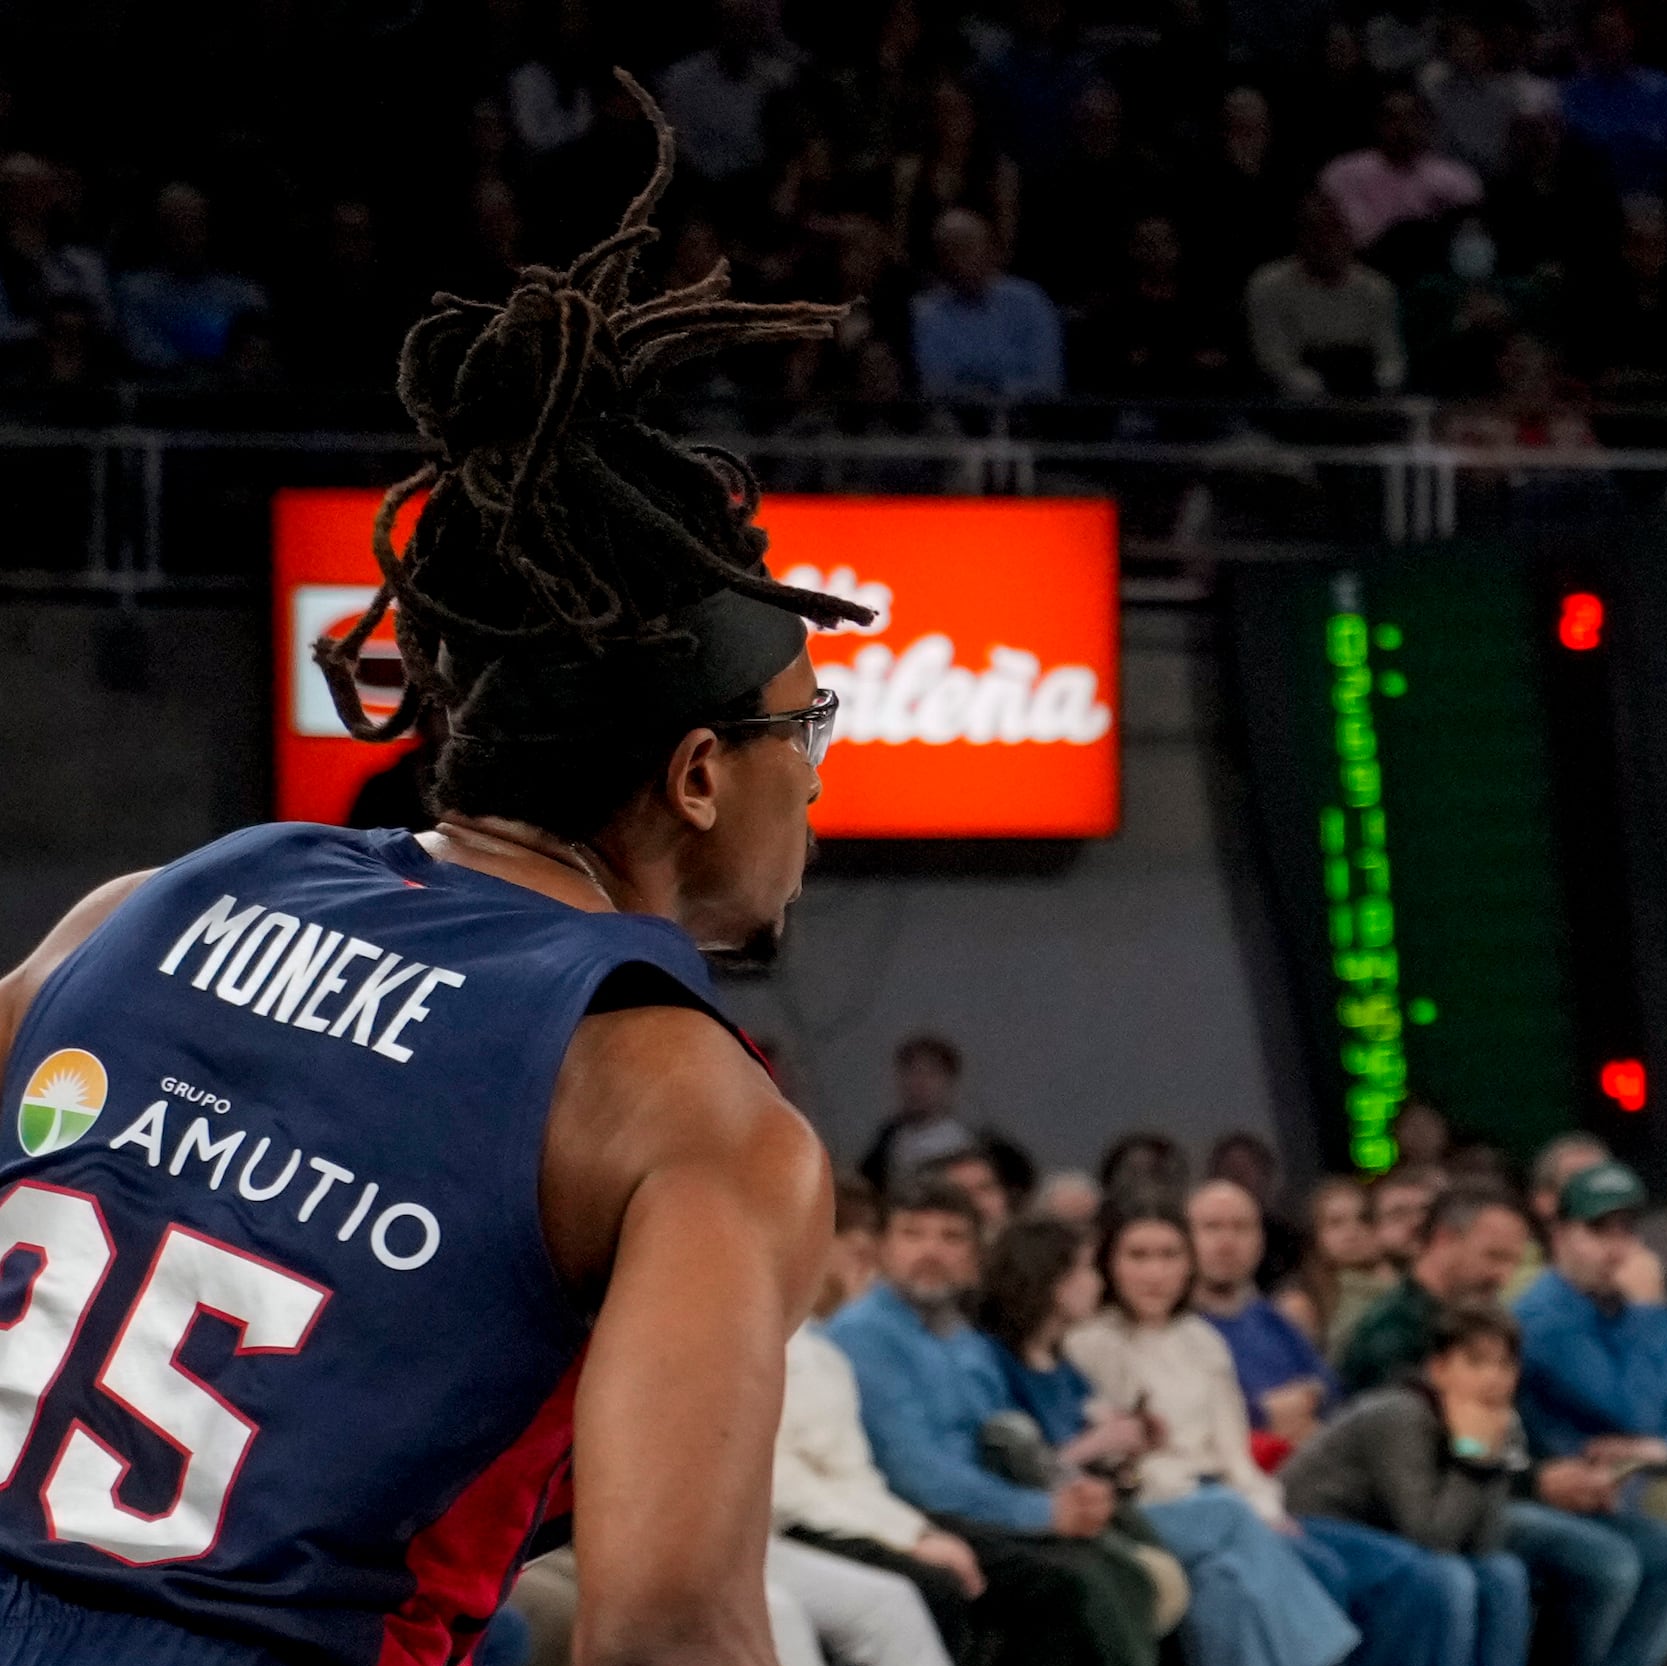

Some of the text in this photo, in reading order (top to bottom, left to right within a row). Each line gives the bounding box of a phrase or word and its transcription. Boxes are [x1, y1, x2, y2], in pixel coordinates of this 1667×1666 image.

[158, 893, 467, 1063] MONEKE
[160, 1076, 232, 1114] GRUPO
[109, 1099, 441, 1271] AMUTIO
